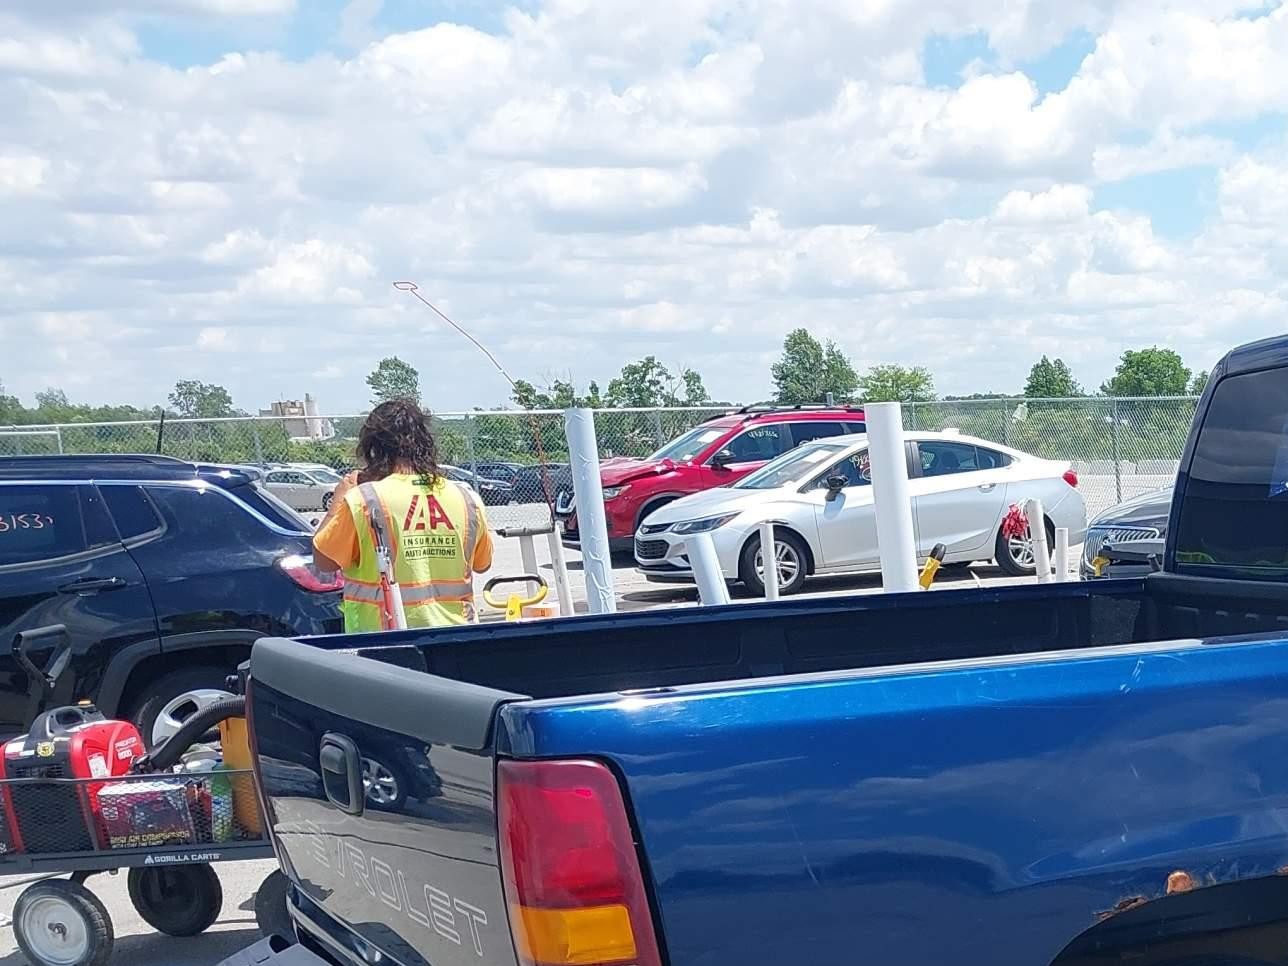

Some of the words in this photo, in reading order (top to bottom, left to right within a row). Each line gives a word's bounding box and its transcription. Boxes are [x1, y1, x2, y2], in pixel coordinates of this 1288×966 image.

[403, 537, 456, 546] INSURANCE
[422, 547, 456, 557] AUCTIONS
[153, 855, 189, 863] GORILLA
[190, 853, 220, 861] CARTS
